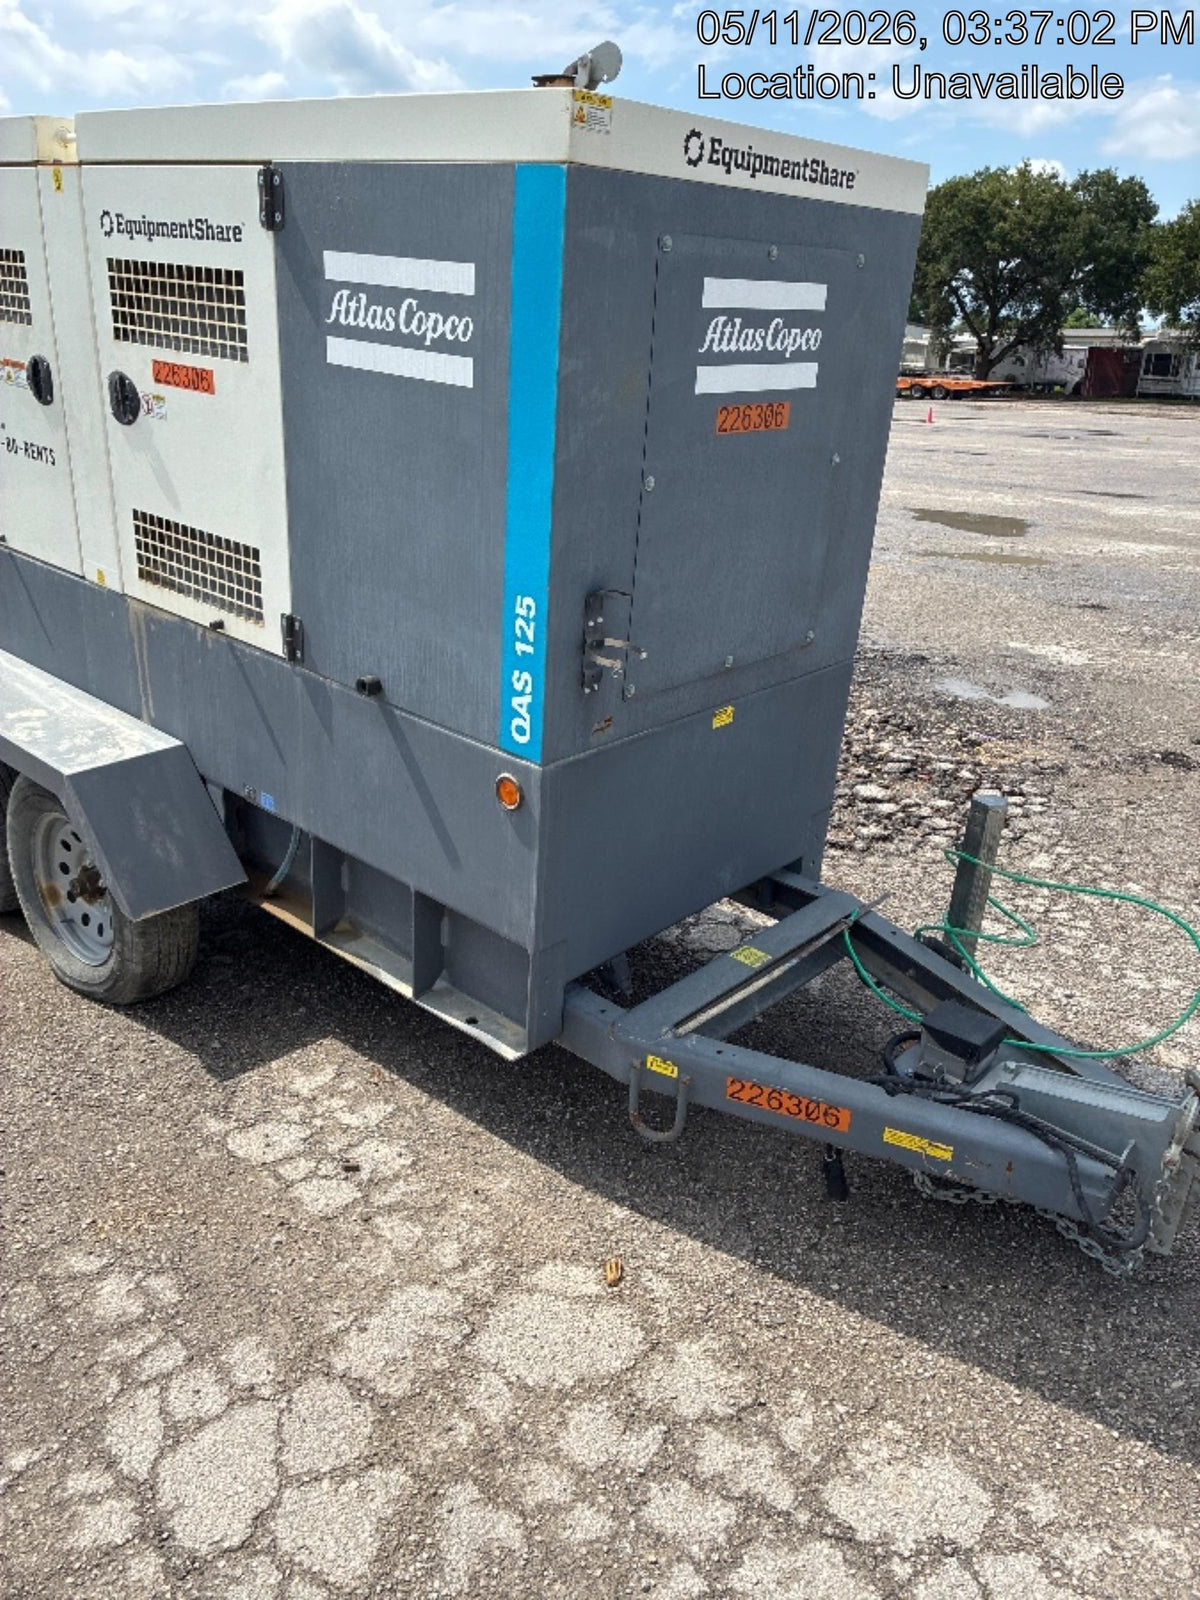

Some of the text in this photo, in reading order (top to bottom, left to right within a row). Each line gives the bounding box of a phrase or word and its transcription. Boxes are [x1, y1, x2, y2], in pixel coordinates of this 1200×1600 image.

[707, 136, 856, 189] EquipmentShare
[115, 212, 242, 243] EquipmentShare
[325, 289, 474, 346] Atlas Copco
[698, 315, 822, 358] Atlas Copco
[152, 360, 211, 393] 226306
[717, 402, 786, 433] 226306
[511, 594, 537, 745] QAS 125
[728, 1077, 842, 1129] 226306
